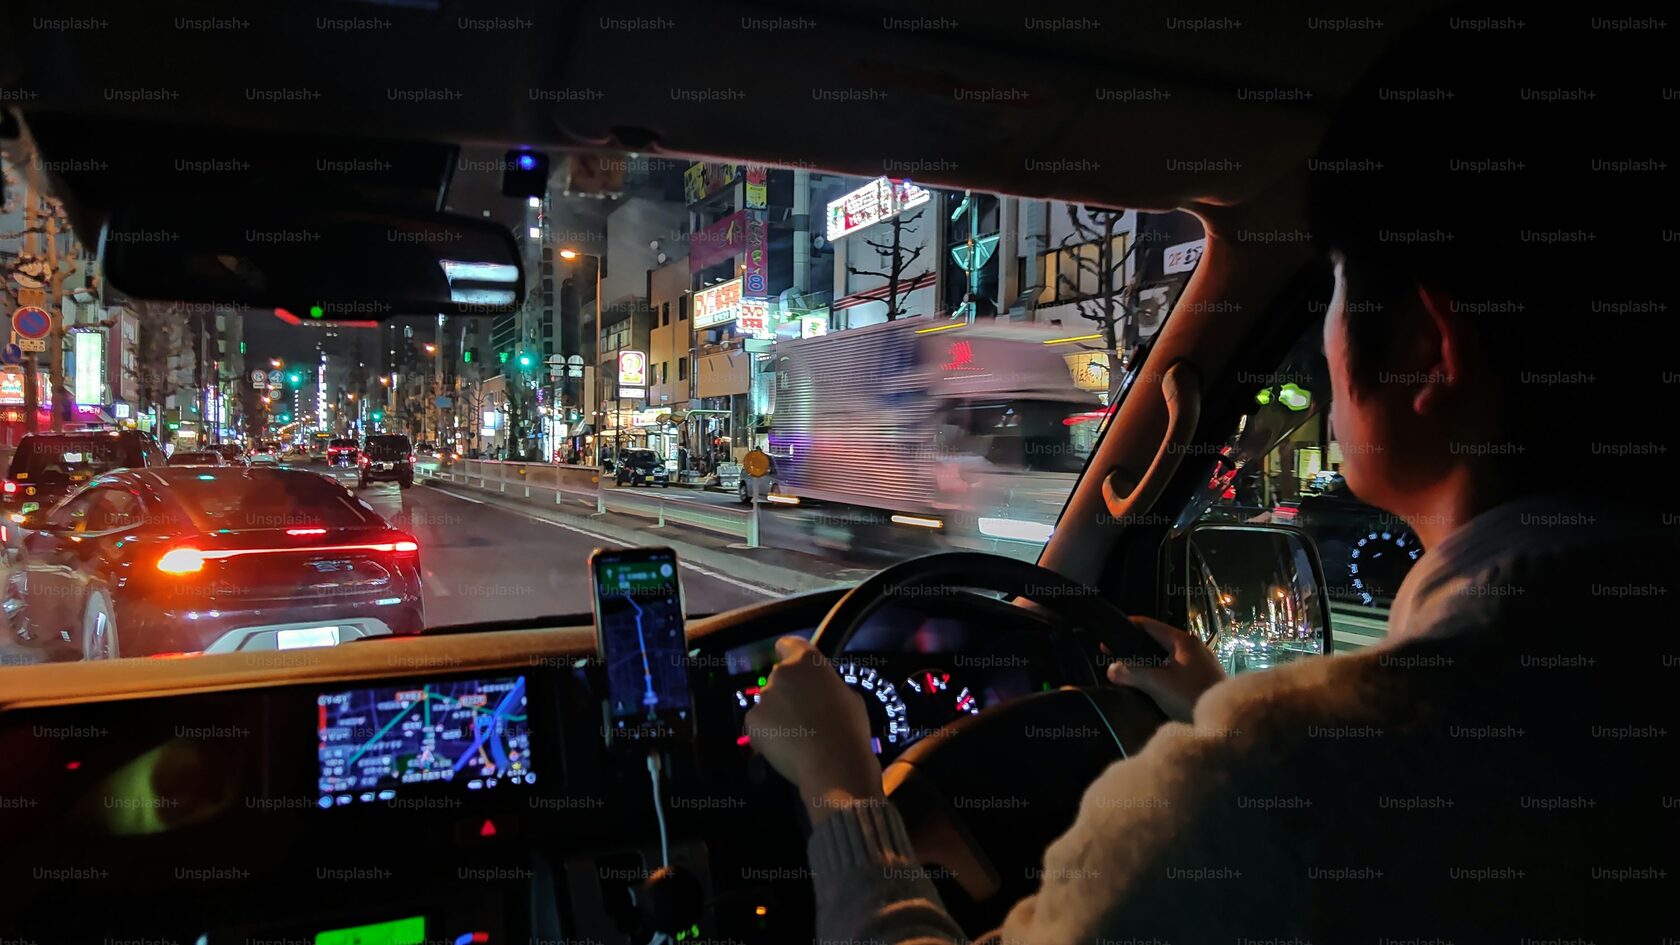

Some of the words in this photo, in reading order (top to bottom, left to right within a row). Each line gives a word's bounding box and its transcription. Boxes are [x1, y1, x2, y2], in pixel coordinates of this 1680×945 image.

[1168, 251, 1183, 267] 2F
[748, 274, 764, 292] 8
[742, 306, 763, 317] DVD
